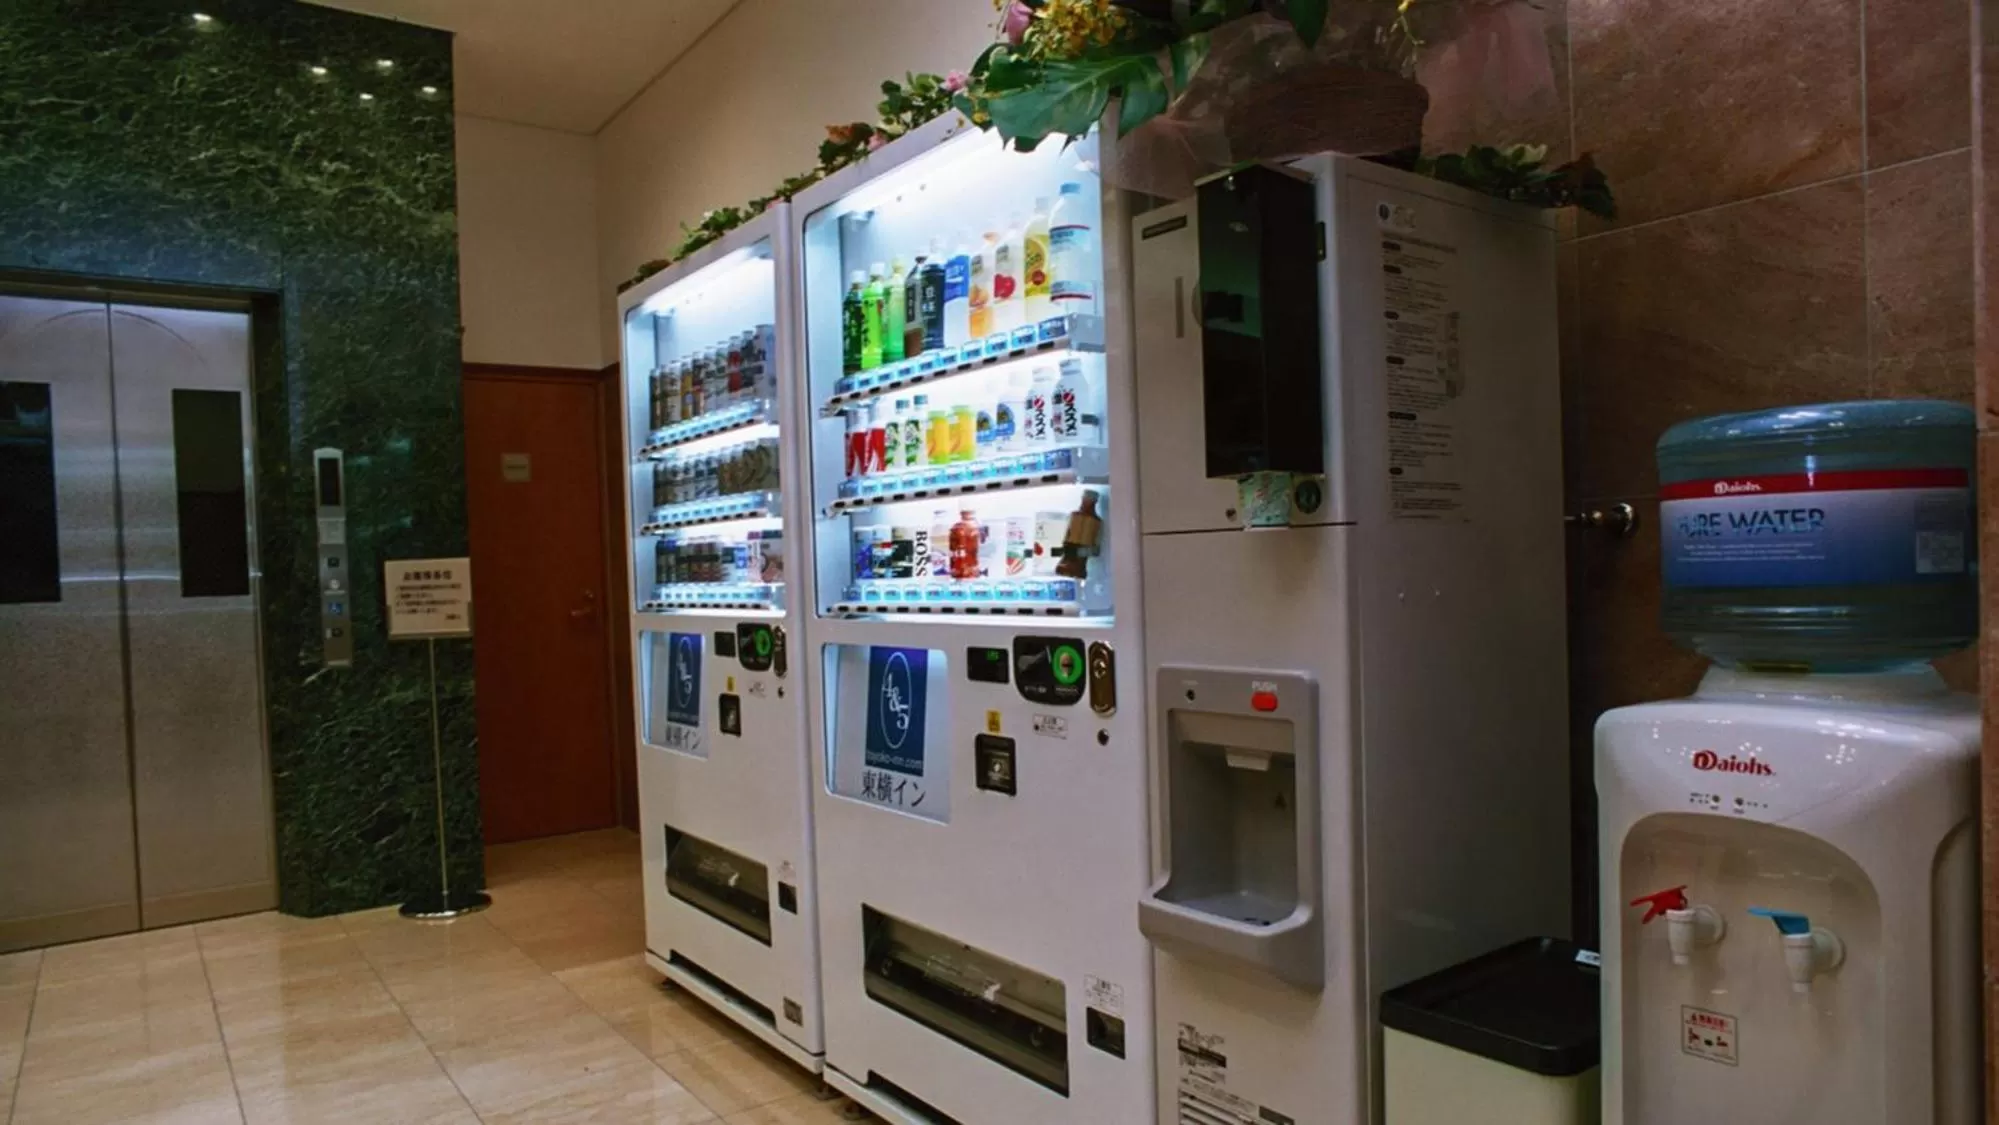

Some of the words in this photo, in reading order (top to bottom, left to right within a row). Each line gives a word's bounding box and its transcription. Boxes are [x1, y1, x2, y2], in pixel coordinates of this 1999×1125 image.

[1728, 507, 1825, 536] WATER
[915, 530, 928, 577] BOSS
[1693, 750, 1773, 776] Daiohs
[861, 769, 926, 807] 東横イン
